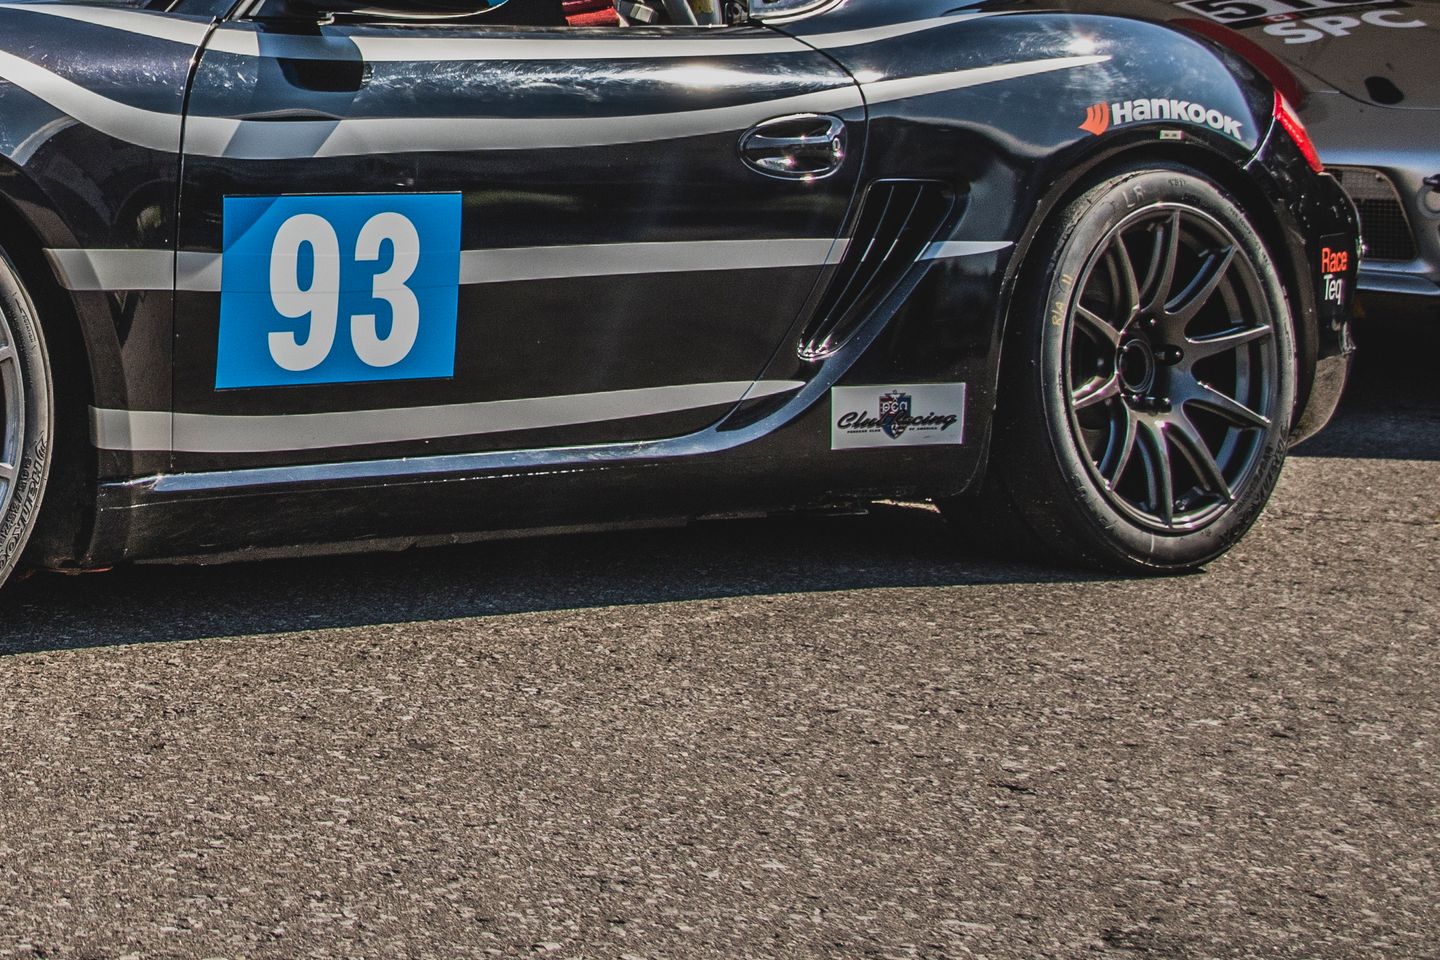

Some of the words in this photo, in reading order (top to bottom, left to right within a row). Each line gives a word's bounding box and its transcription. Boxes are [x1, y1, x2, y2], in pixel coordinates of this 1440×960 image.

[1262, 10, 1427, 45] SPC
[1321, 247, 1348, 274] Race
[267, 211, 421, 372] 93
[1323, 273, 1343, 306] Teq
